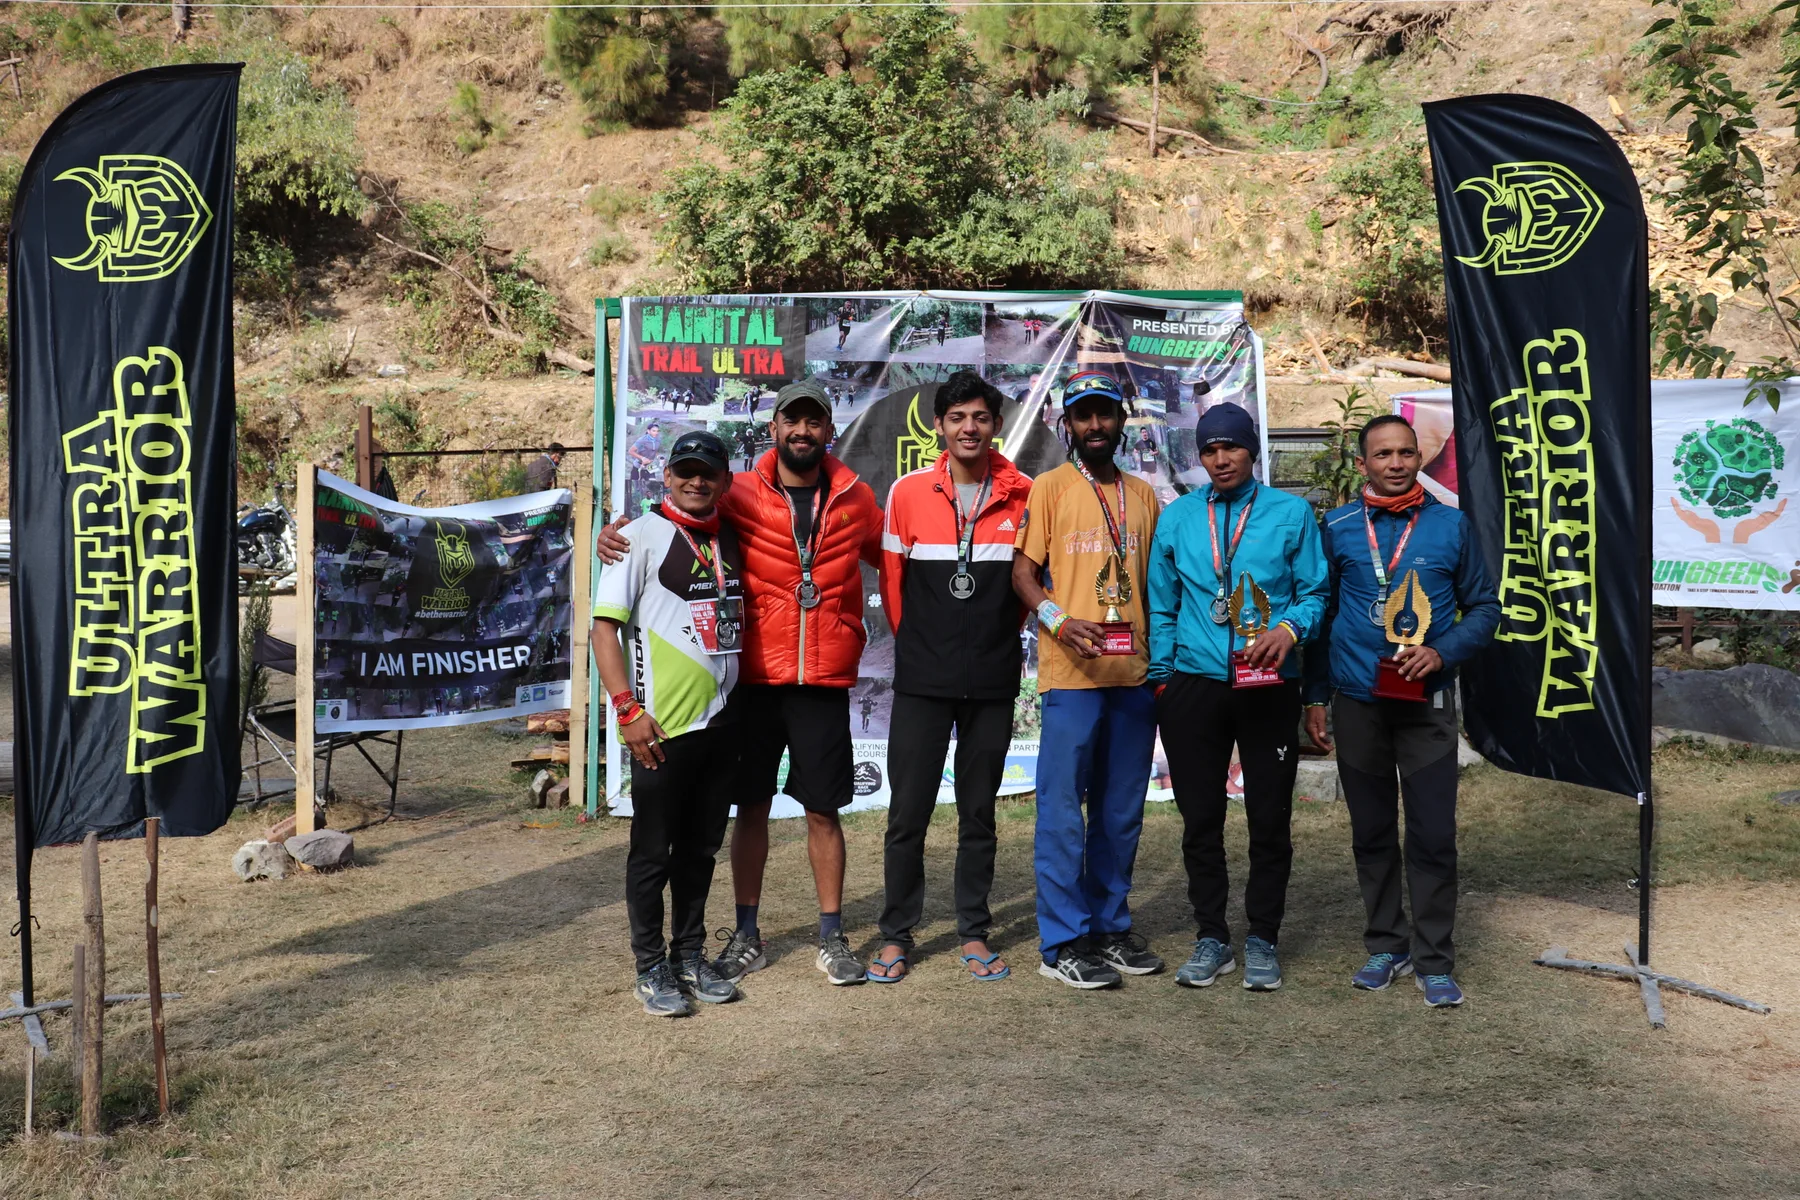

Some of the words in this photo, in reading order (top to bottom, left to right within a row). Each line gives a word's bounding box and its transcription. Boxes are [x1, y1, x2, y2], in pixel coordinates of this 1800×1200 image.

[641, 305, 784, 346] NAINITAL
[1132, 319, 1217, 336] PRESENTED
[640, 346, 703, 373] TRAIL
[1081, 467, 1094, 482] KM
[1489, 387, 1551, 643] ULTRA
[1522, 327, 1599, 719] WARRIOR
[62, 408, 137, 697] ULTRA
[1065, 541, 1103, 555] UTMB
[113, 345, 207, 774] WARRIOR
[433, 587, 466, 599] ULTRA
[688, 579, 740, 592] MEDA
[421, 595, 470, 610] WARRIOR
[414, 610, 468, 618] #bethewarrior
[360, 652, 367, 676] I
[372, 652, 406, 676] AM
[411, 644, 531, 676] FINISHER
[634, 625, 646, 709] ERIDA
[854, 743, 887, 751] LIFYING
